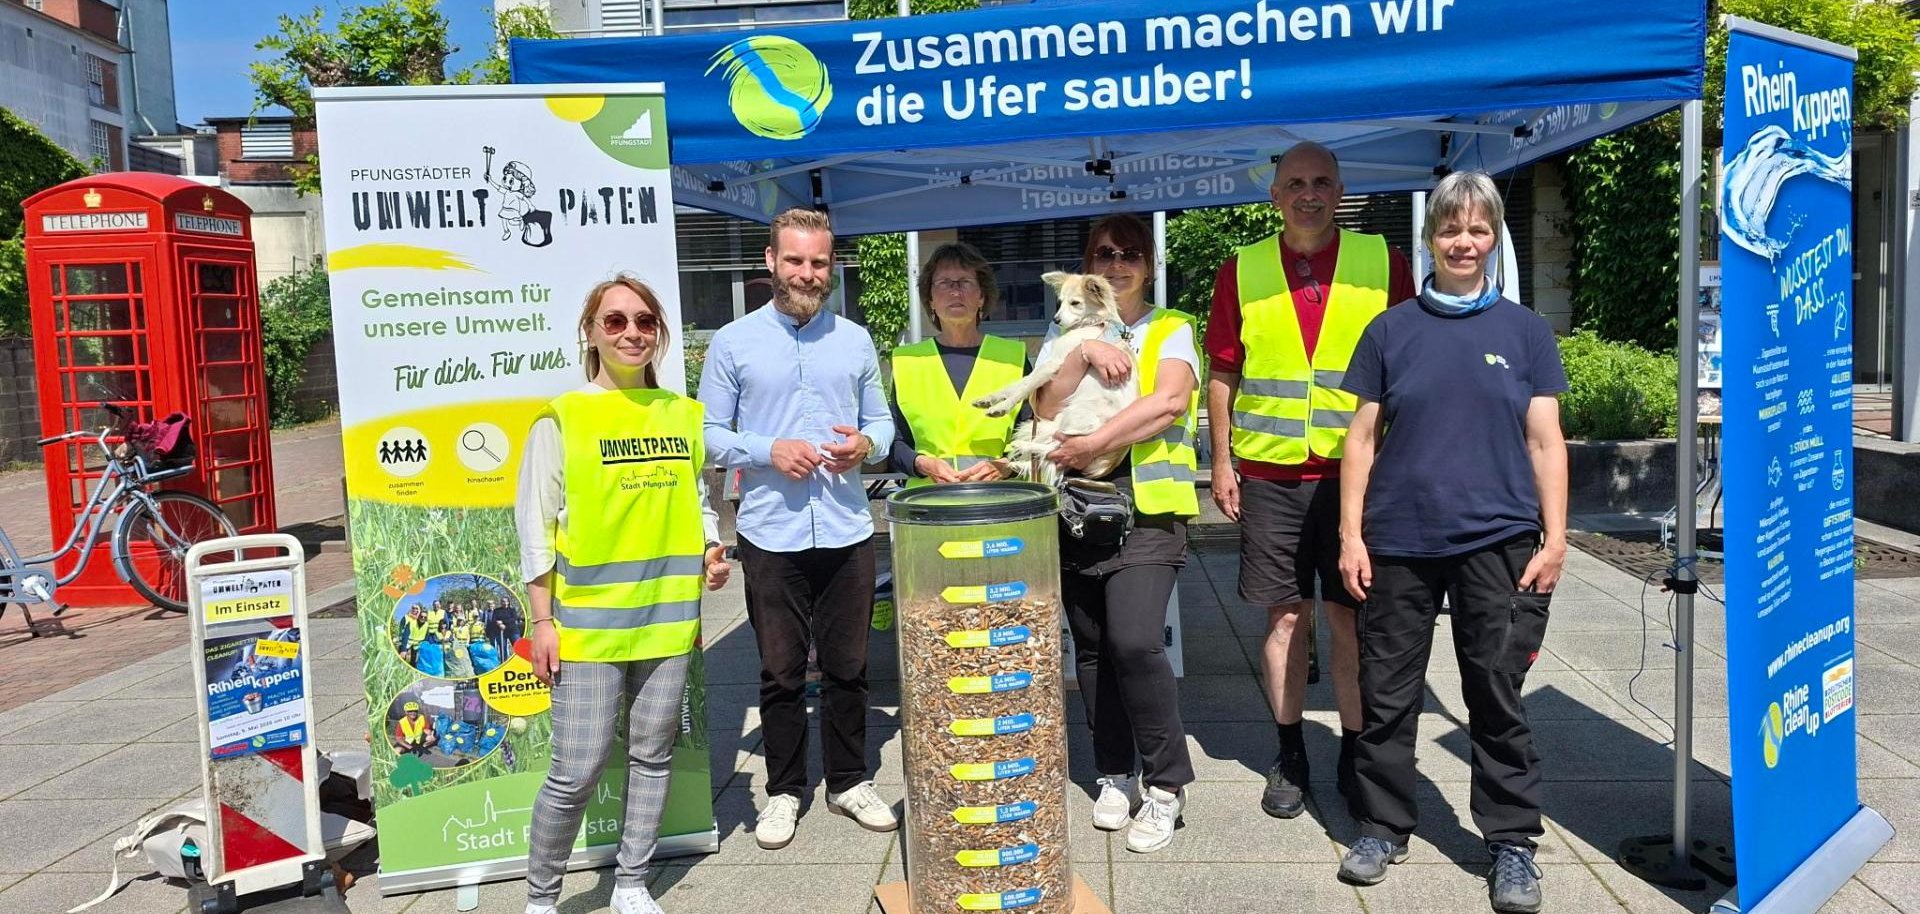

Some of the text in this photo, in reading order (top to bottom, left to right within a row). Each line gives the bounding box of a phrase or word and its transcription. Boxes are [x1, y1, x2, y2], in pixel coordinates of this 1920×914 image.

[852, 0, 1454, 75] Zusammen machen wir
[856, 59, 1252, 126] die Ufer sauber!
[1742, 60, 1797, 118] Rhein
[1793, 86, 1850, 142] kippen
[351, 165, 471, 181] PFUNGSTÄDTER
[352, 186, 658, 231] UMWELT PATEN
[46, 214, 145, 230] TELEPHONE
[178, 213, 240, 234] TELEPHONE
[1781, 235, 1834, 301] WUSSTEST
[361, 284, 552, 309] Gemeinsam für
[364, 313, 552, 338] unsere Umwelt.
[394, 364, 426, 391] Für
[434, 356, 485, 386] dich.
[490, 351, 525, 378] Für
[530, 347, 572, 370] uns.
[600, 437, 690, 458] UMWELTPATEN
[213, 583, 243, 593] UMWELT
[215, 600, 281, 615] Im Einsatz
[205, 645, 218, 654] DAS
[1767, 615, 1850, 679] www.rhinecleanup.org
[488, 680, 547, 694] Ehrent
[504, 670, 533, 682] Der
[1783, 684, 1809, 718] Rhine
[1784, 704, 1819, 737] clean up
[456, 827, 514, 851] Stadt
